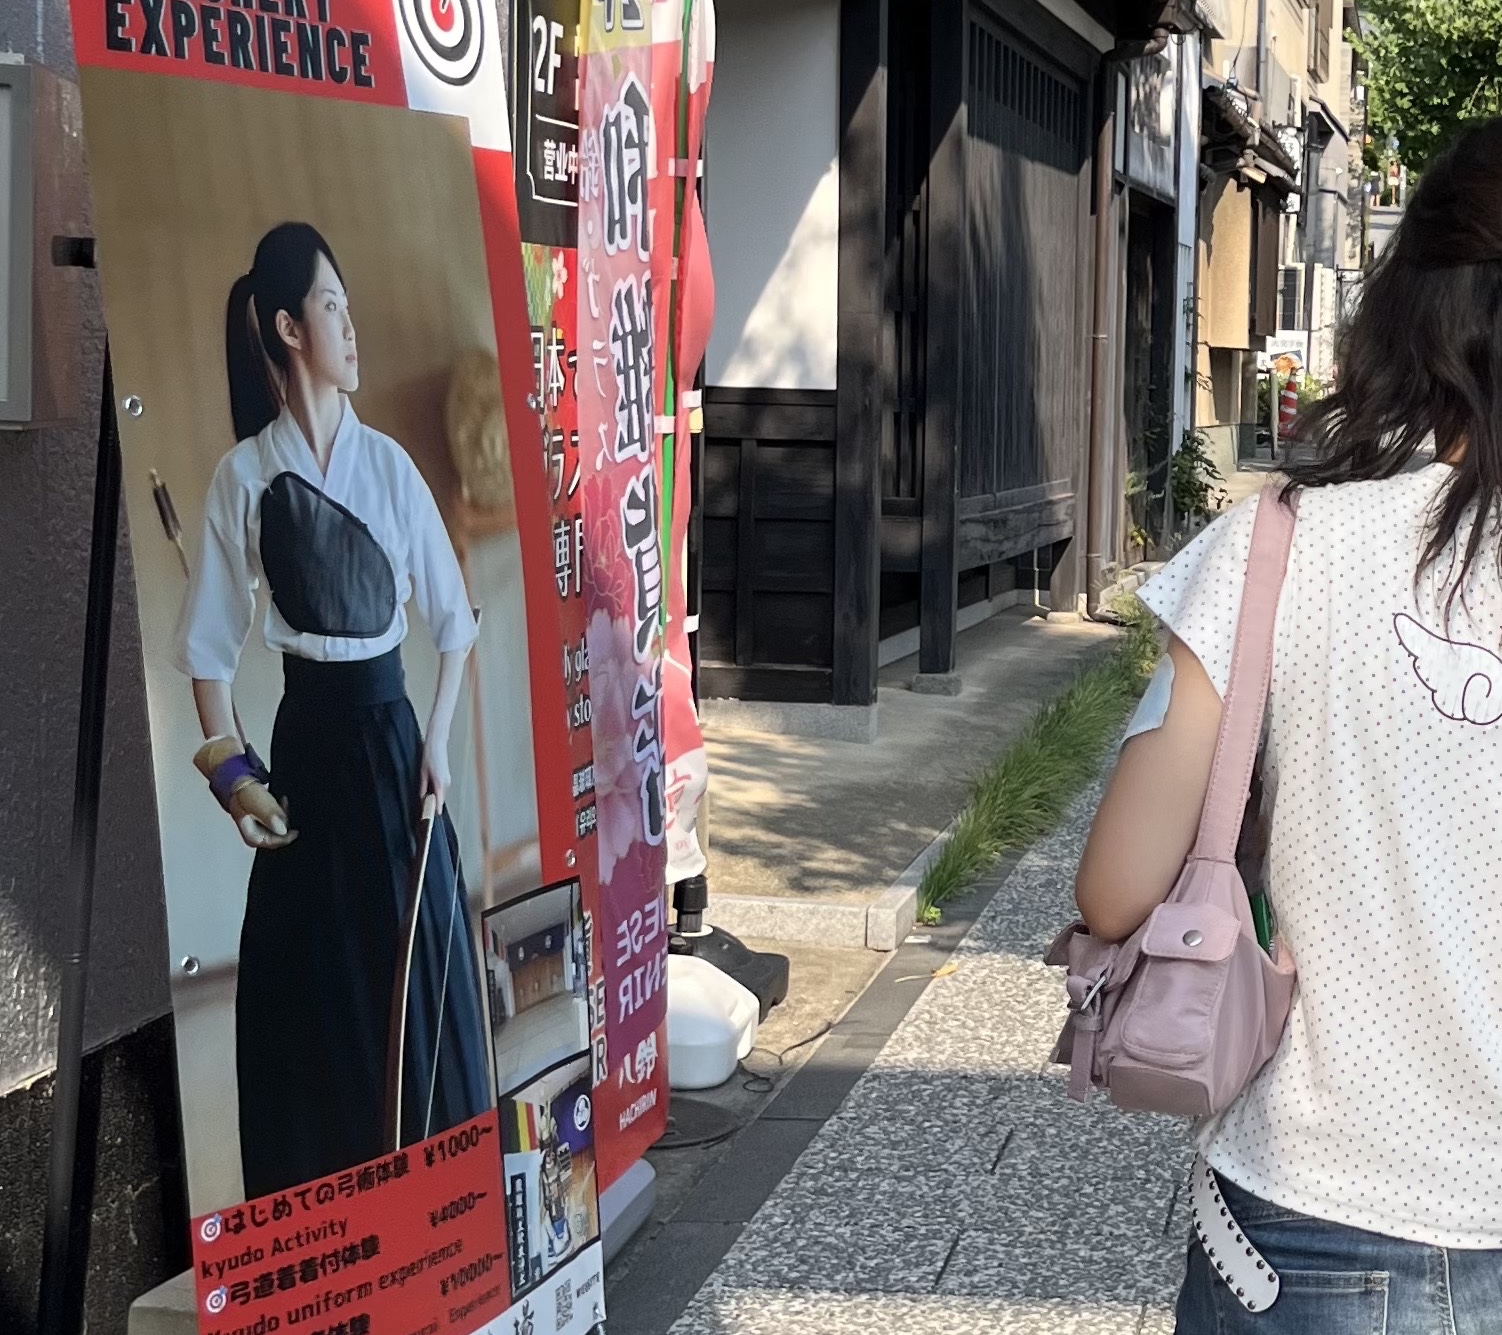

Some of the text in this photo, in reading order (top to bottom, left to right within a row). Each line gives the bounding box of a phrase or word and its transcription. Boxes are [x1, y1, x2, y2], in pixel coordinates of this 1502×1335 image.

[532, 14, 564, 95] 2F
[223, 1151, 410, 1235] はじめての弓術体験
[201, 1216, 349, 1280] kyudo Activity
[286, 1279, 373, 1325] uniform
